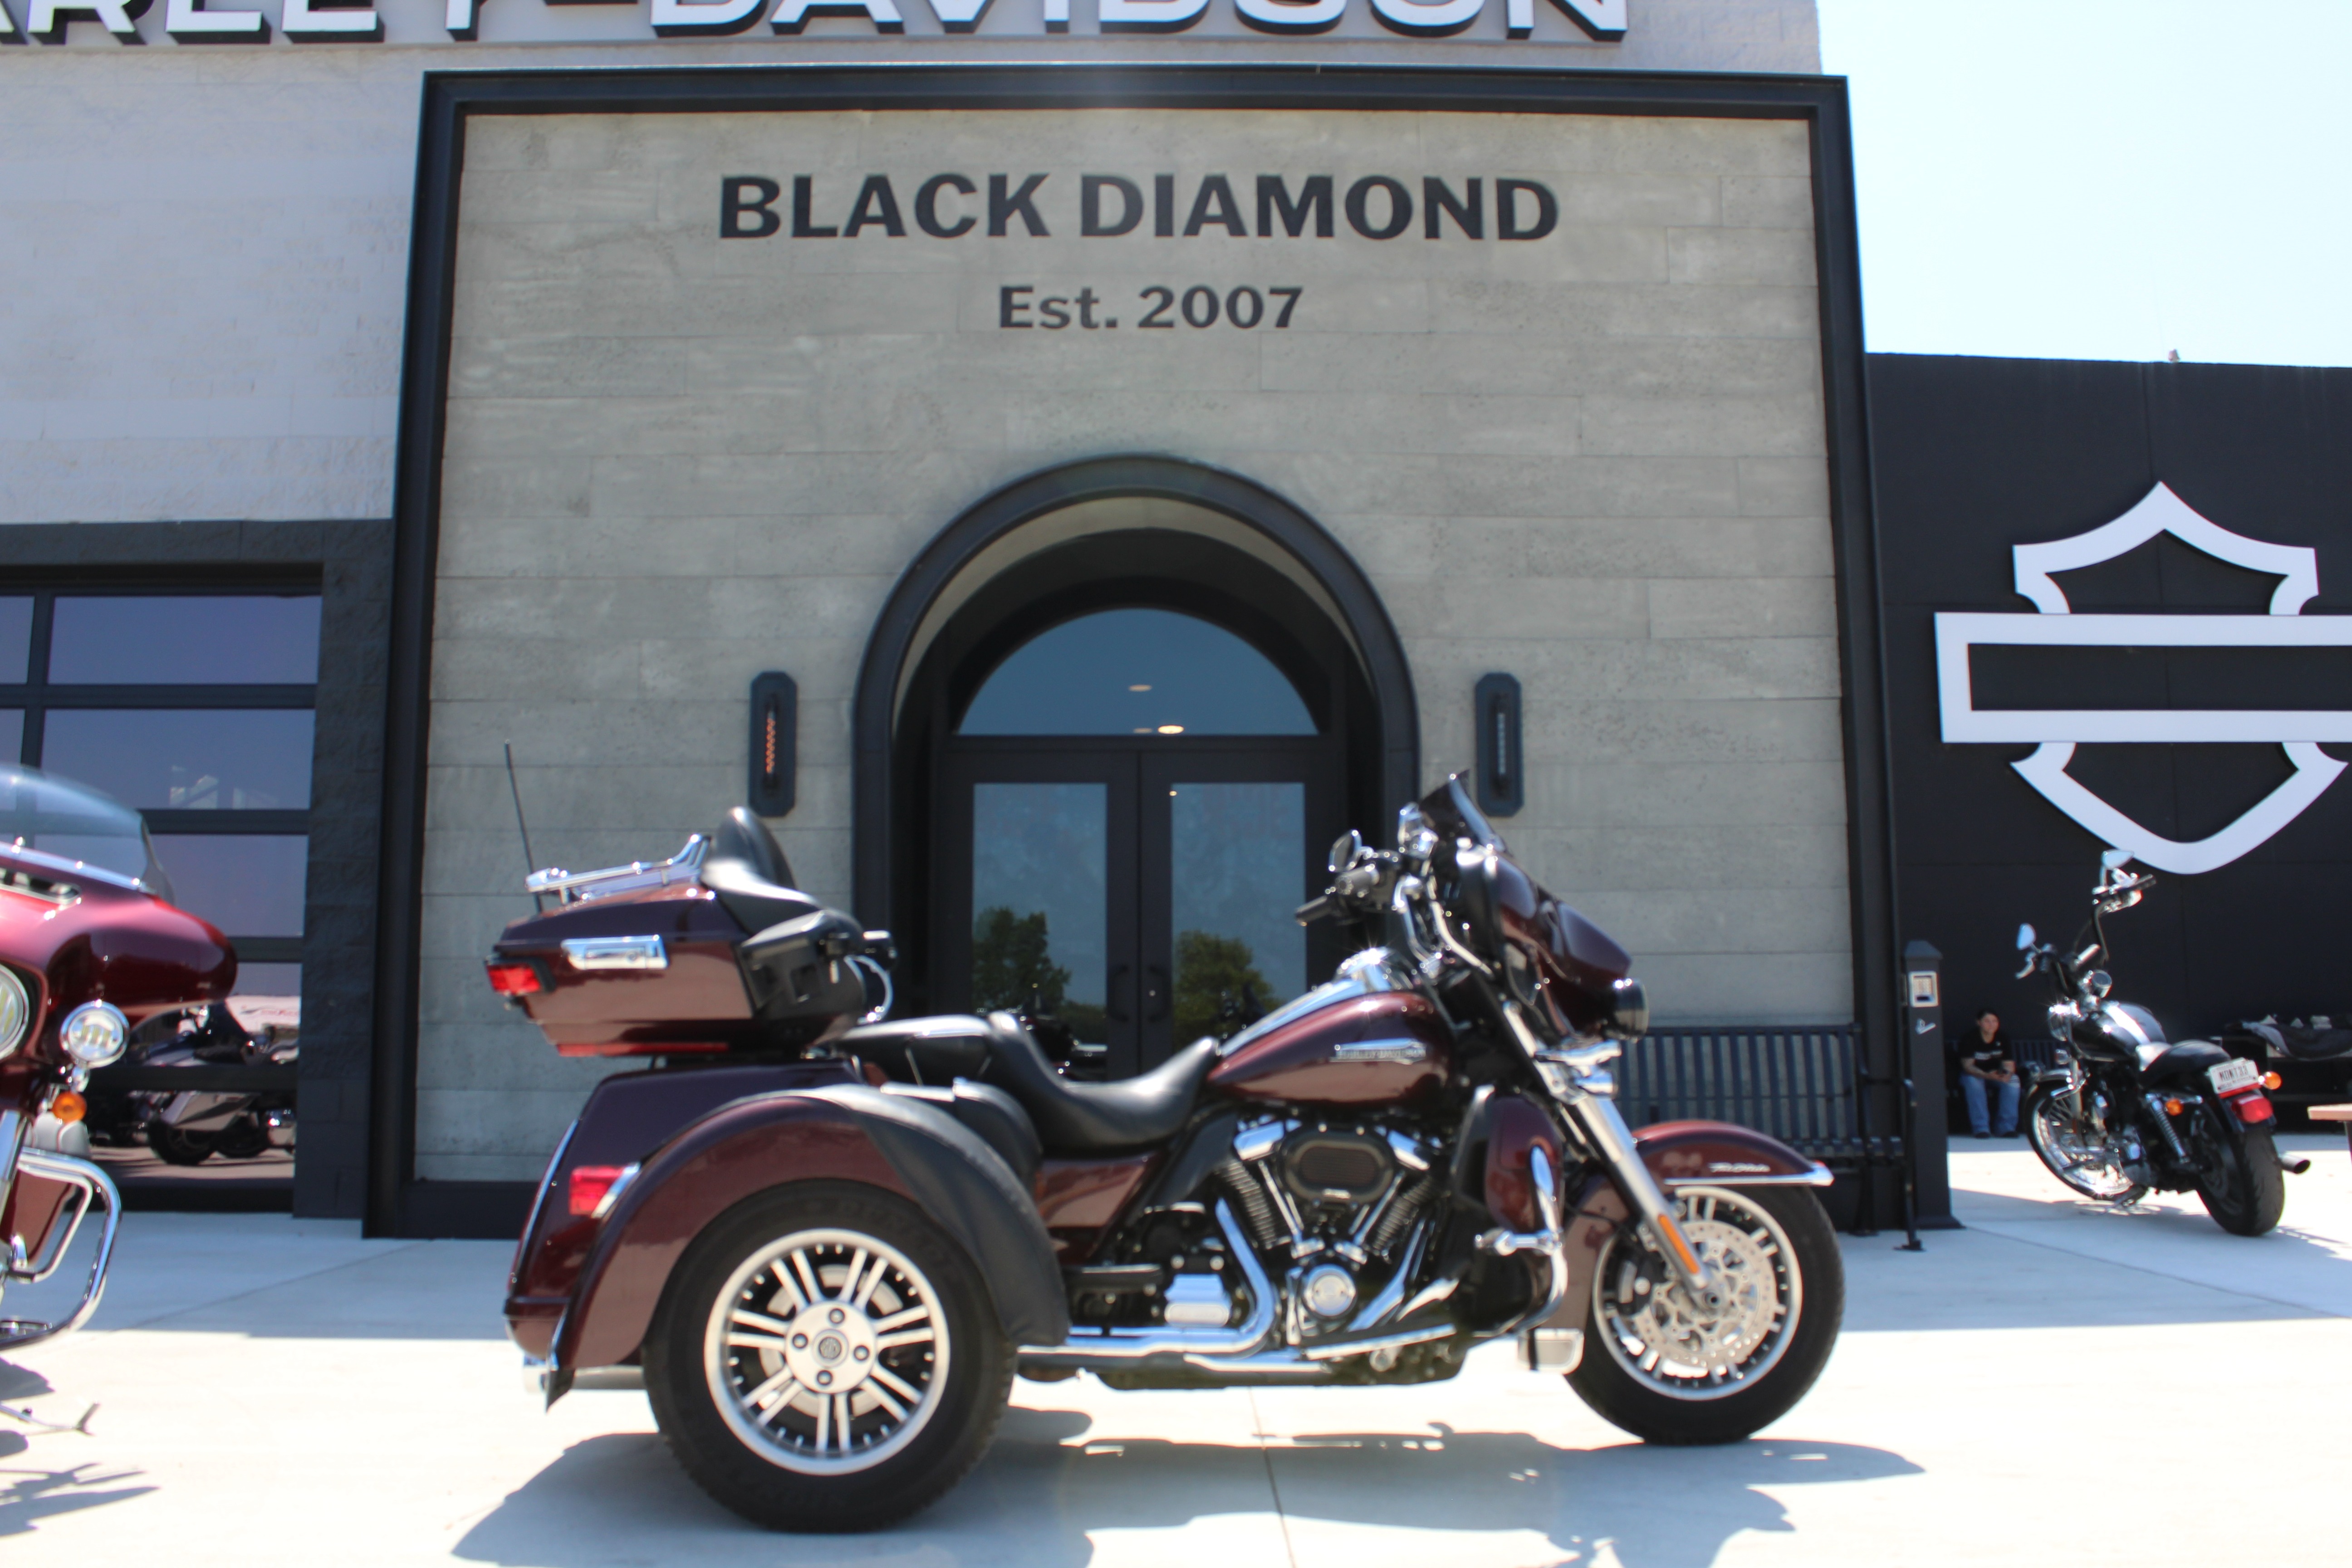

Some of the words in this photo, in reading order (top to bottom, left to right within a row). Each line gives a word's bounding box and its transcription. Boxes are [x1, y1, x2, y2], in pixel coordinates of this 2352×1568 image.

[719, 173, 1050, 239] BLACK
[1080, 175, 1558, 241] DIAMOND
[1000, 286, 1117, 329] Est.
[1138, 286, 1303, 329] 2007
